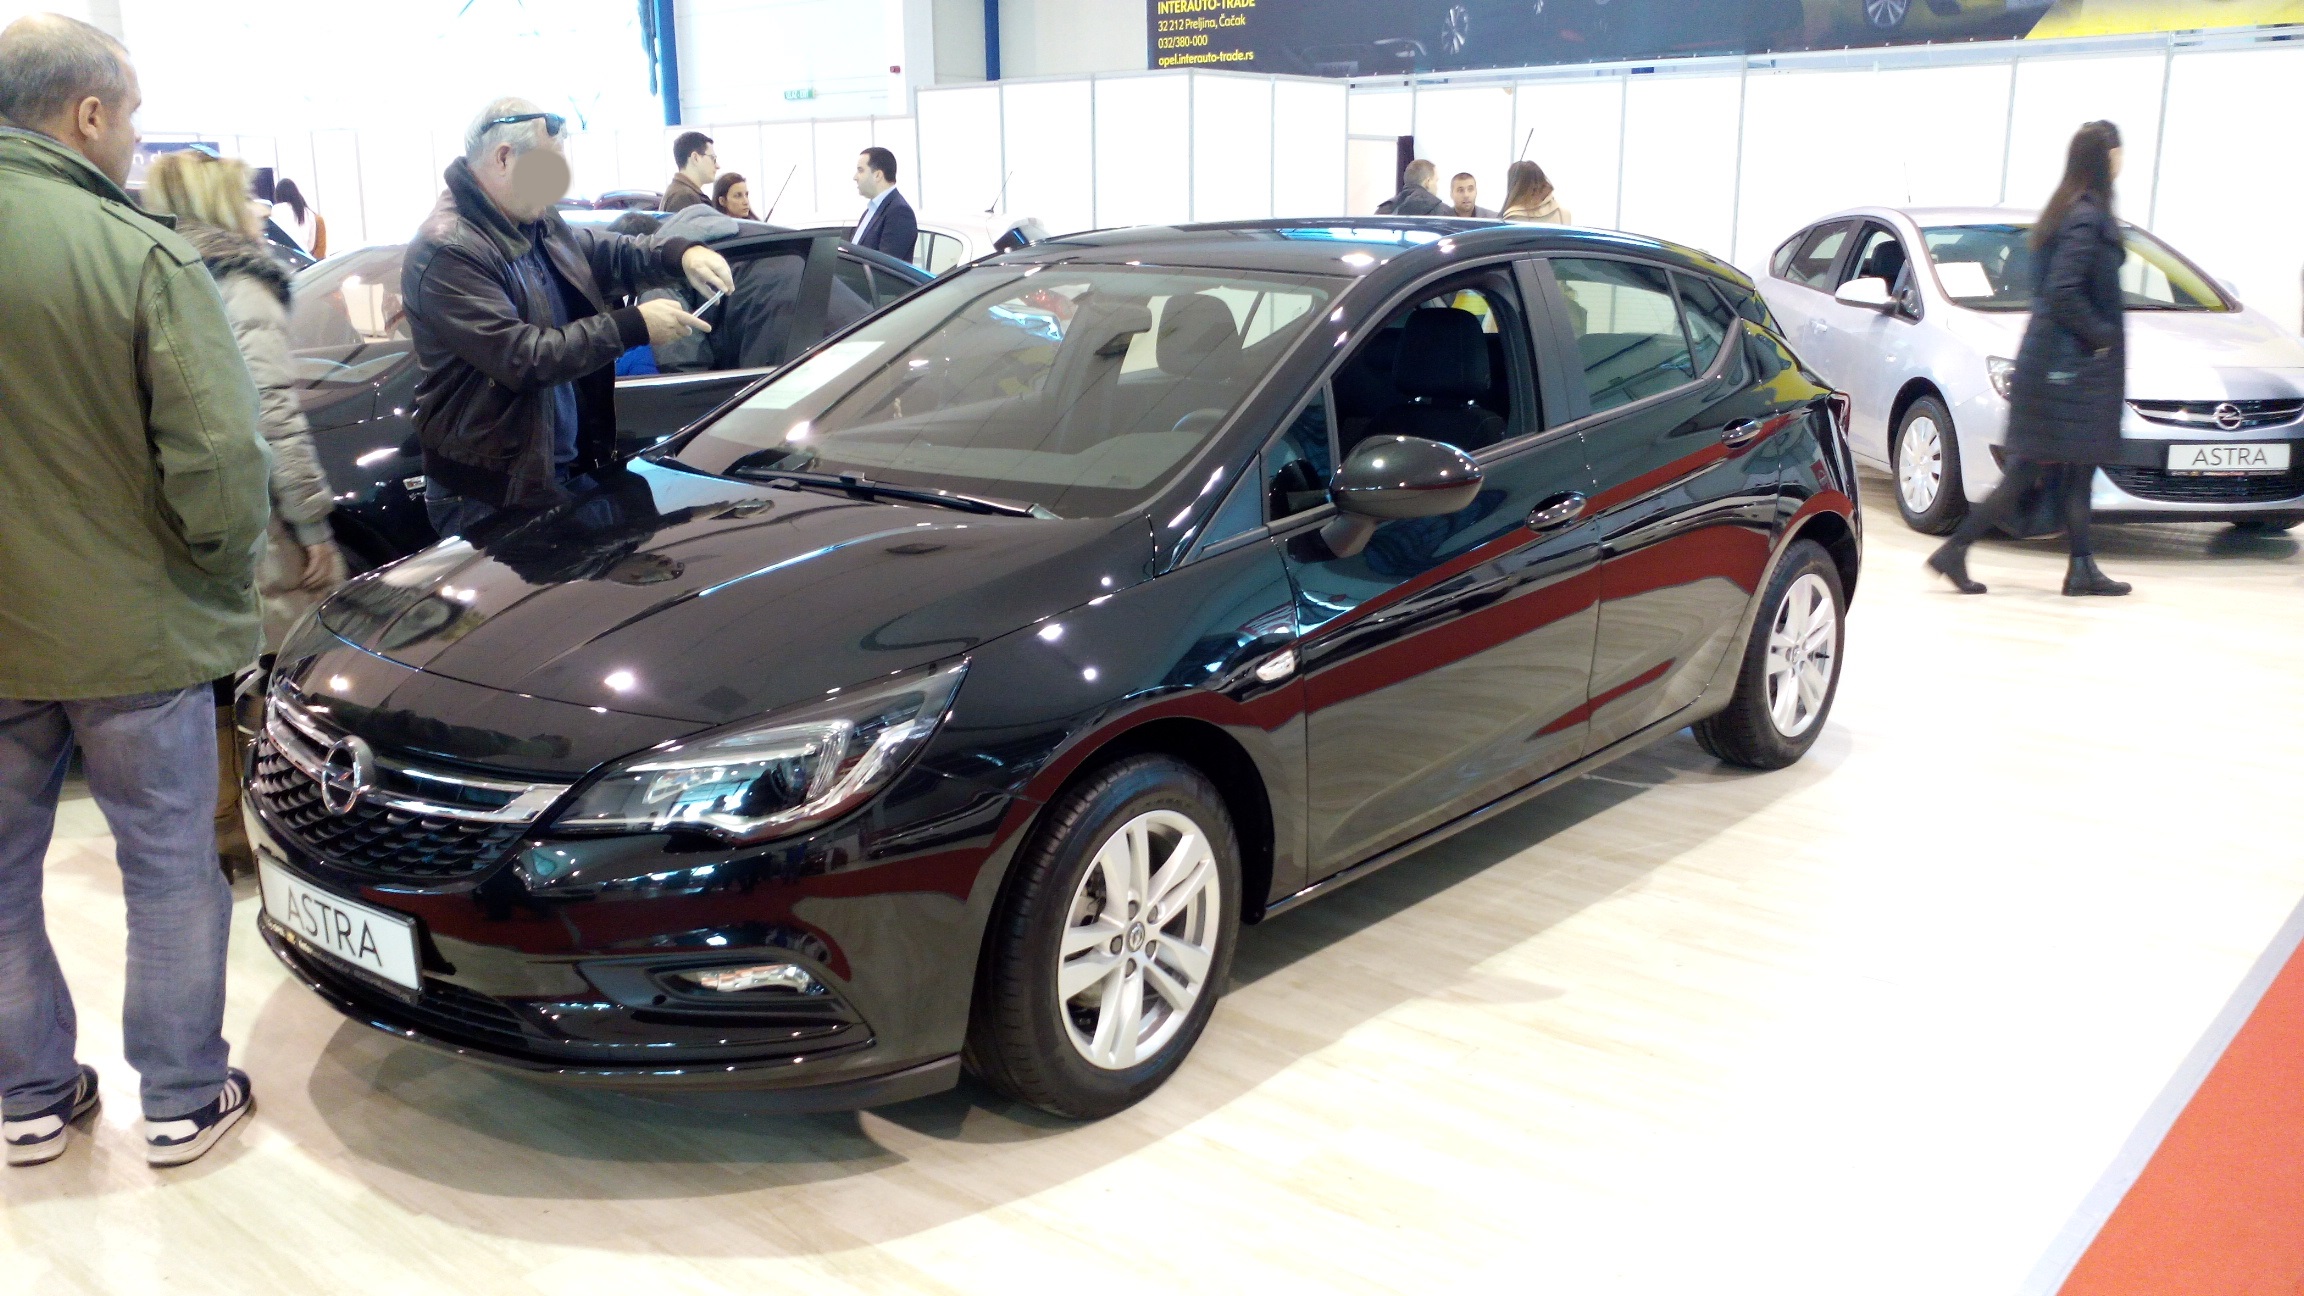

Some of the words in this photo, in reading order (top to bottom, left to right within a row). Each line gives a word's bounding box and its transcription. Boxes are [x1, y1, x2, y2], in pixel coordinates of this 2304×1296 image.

[1158, 0, 1255, 15] INTERAUTO-TRADE
[1158, 20, 1168, 31] 32
[1169, 19, 1184, 31] 212
[1185, 16, 1218, 31] Preljina,
[1219, 13, 1246, 27] Čačak
[1158, 34, 1208, 49] 032/380-000
[1158, 49, 1254, 68] opel.interauto-trade.rs
[2192, 447, 2267, 466] ASTRA
[288, 884, 382, 968] ASTRA
